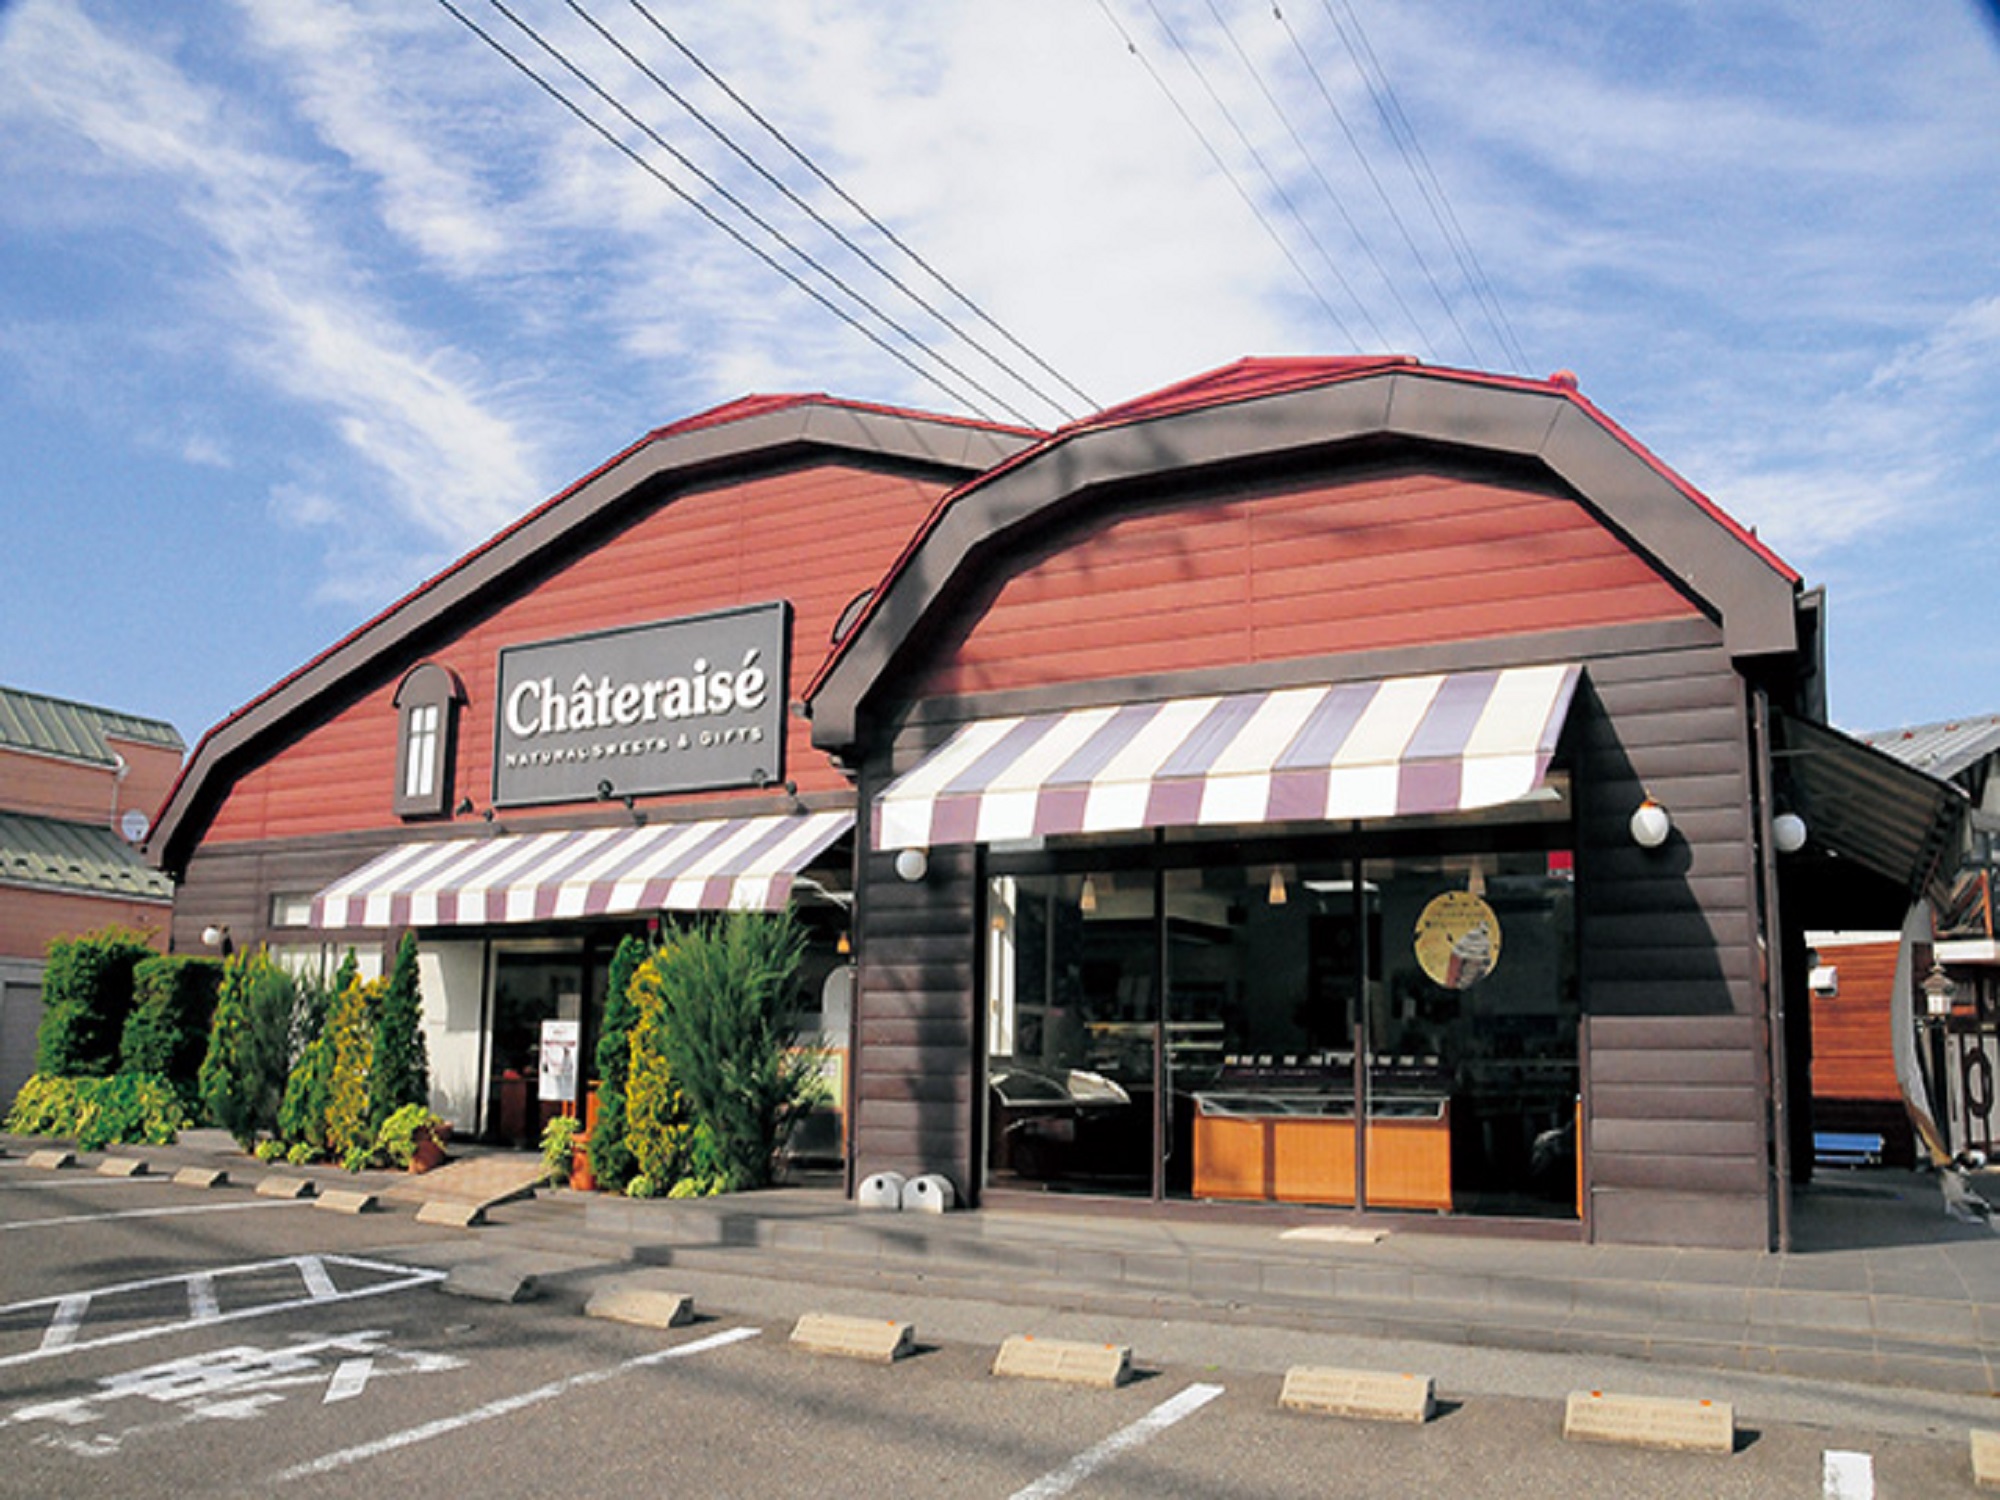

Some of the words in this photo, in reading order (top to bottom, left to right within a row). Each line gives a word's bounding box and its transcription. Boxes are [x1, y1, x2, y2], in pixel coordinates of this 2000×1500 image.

[506, 648, 766, 737] Châteraisé
[505, 746, 590, 768] NATURAL
[591, 737, 668, 759] SWEETS
[677, 731, 691, 750] &
[700, 726, 763, 747] GIFTS
